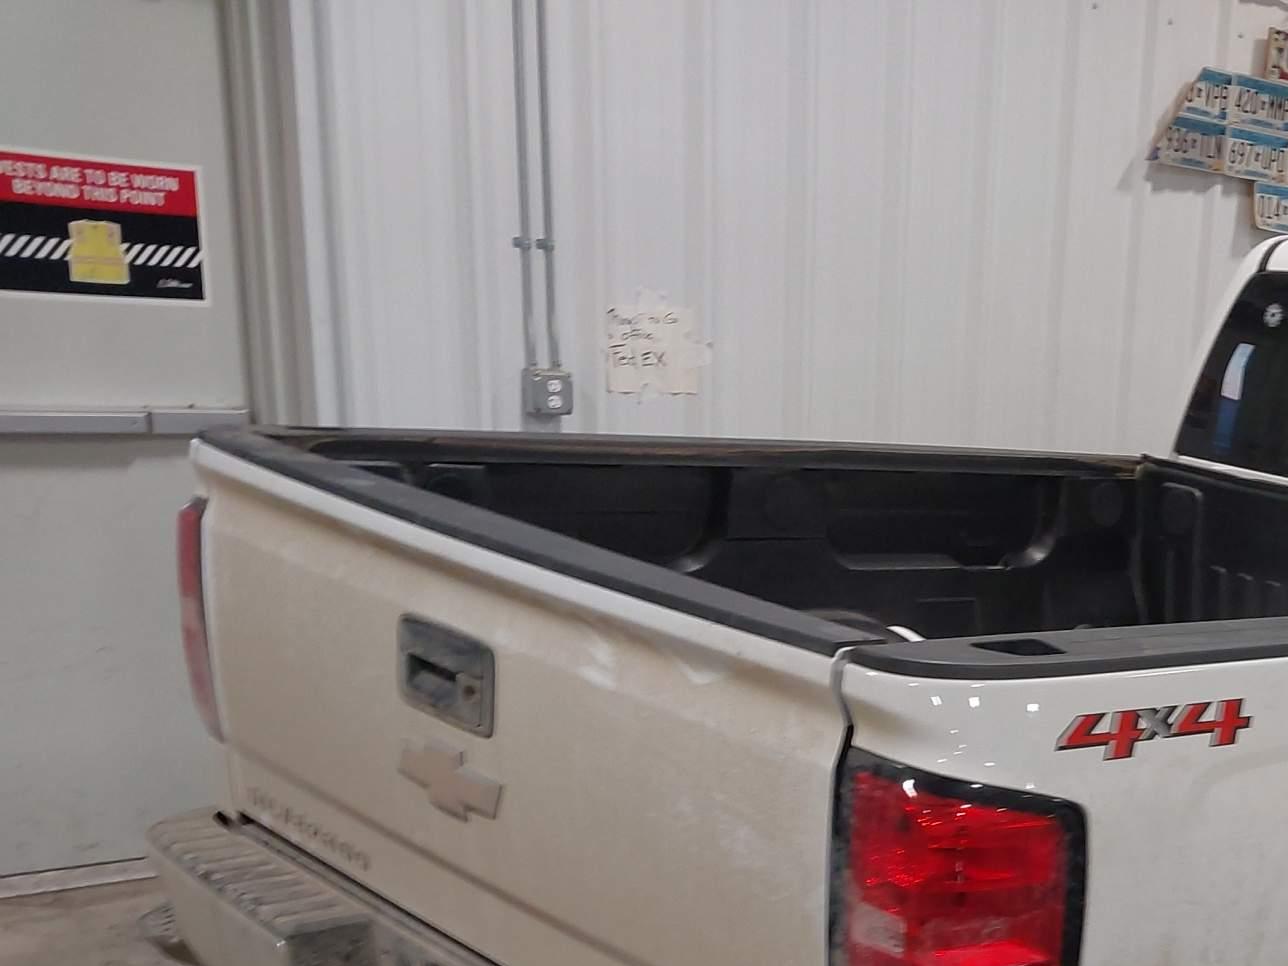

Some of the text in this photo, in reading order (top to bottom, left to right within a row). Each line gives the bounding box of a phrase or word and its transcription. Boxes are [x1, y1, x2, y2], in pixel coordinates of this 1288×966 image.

[50, 165, 83, 183] ARE
[83, 168, 106, 185] TO
[107, 171, 131, 187] BE
[130, 173, 179, 191] WORN
[12, 178, 167, 206] BEYOND THIS POINT
